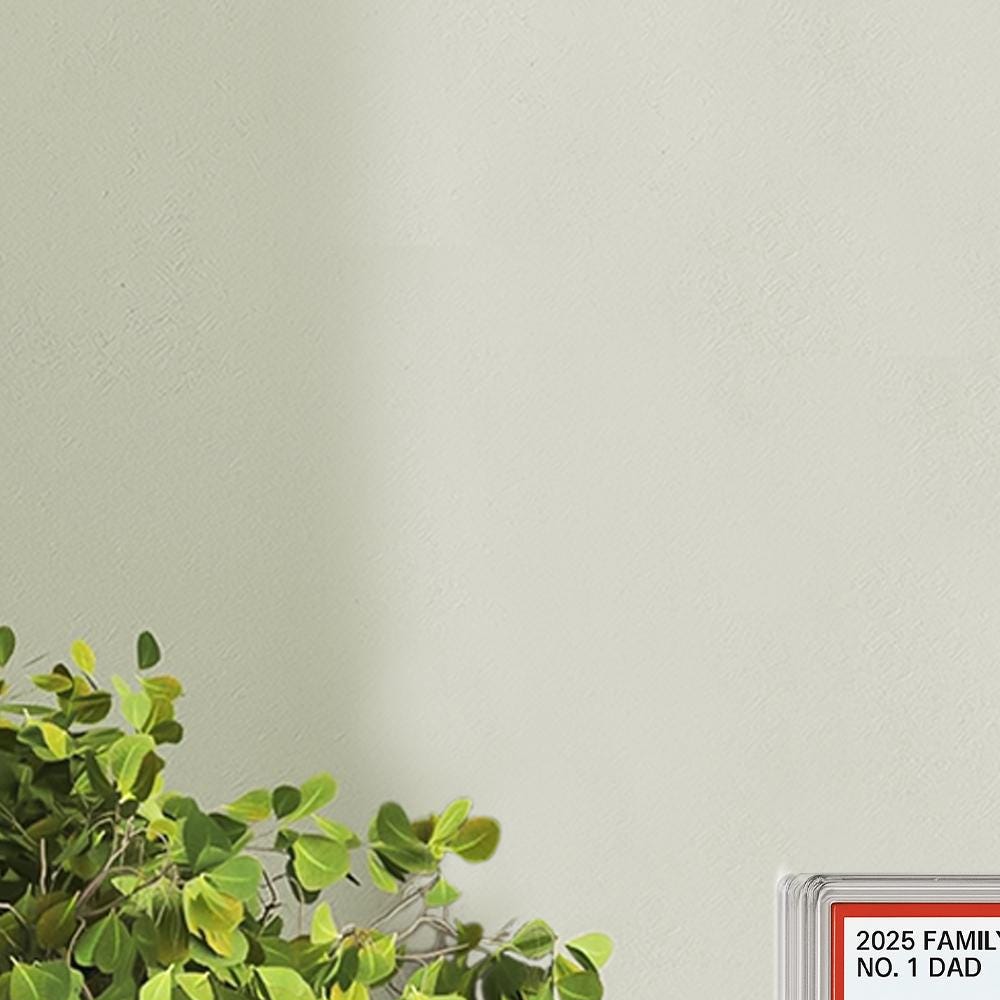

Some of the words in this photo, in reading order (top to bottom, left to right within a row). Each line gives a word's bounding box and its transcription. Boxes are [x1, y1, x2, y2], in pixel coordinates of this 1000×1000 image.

[856, 930, 915, 951] 2025
[857, 957, 899, 978] NO.
[907, 957, 918, 978] 1
[929, 957, 982, 978] DAD
